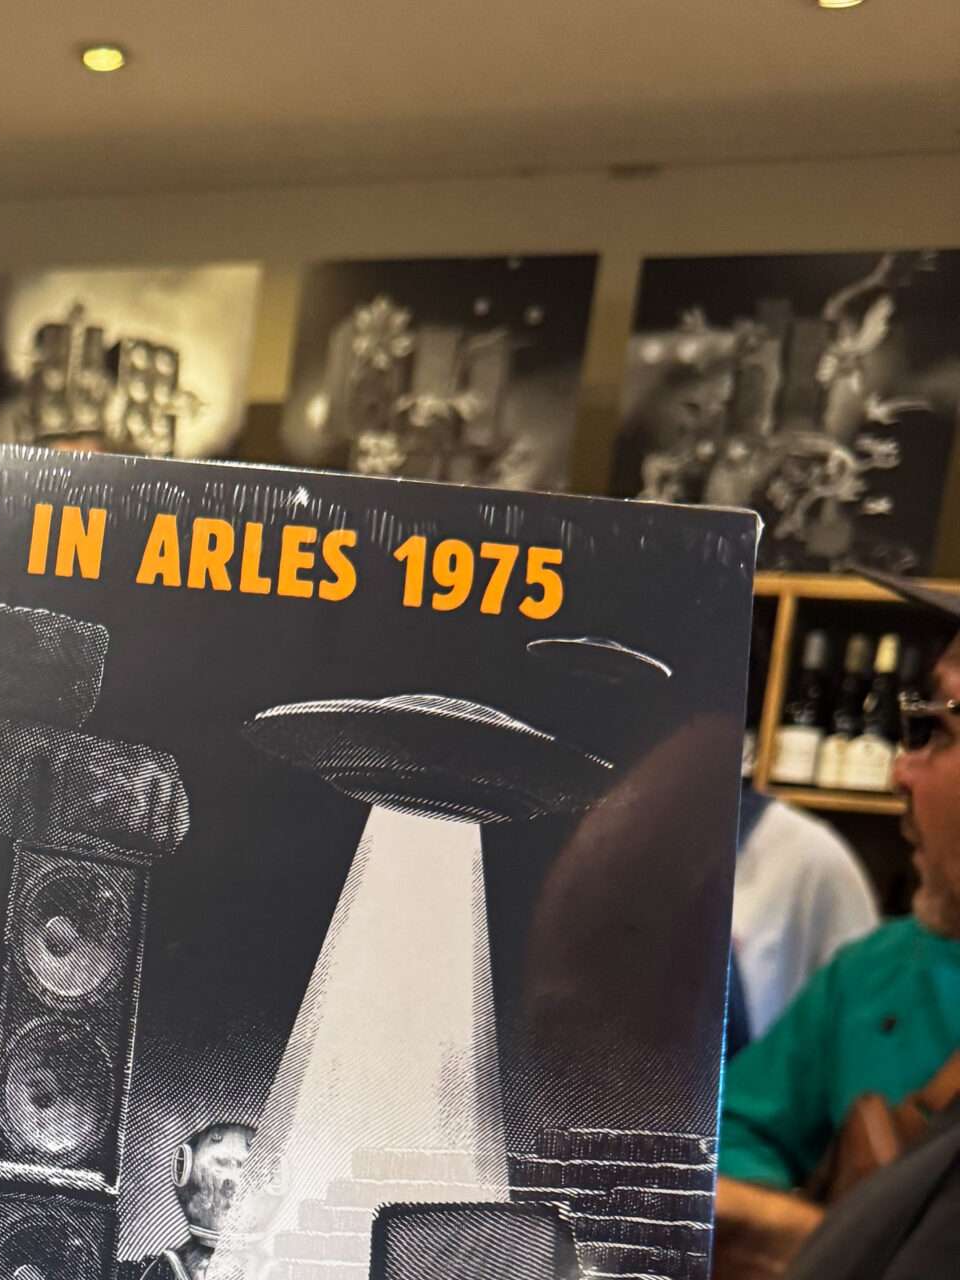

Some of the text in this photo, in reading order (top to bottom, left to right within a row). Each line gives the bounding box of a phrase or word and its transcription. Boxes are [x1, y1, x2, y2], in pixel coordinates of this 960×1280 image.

[27, 503, 107, 580] IN
[136, 513, 358, 603] ARLES
[393, 534, 564, 621] 1975
